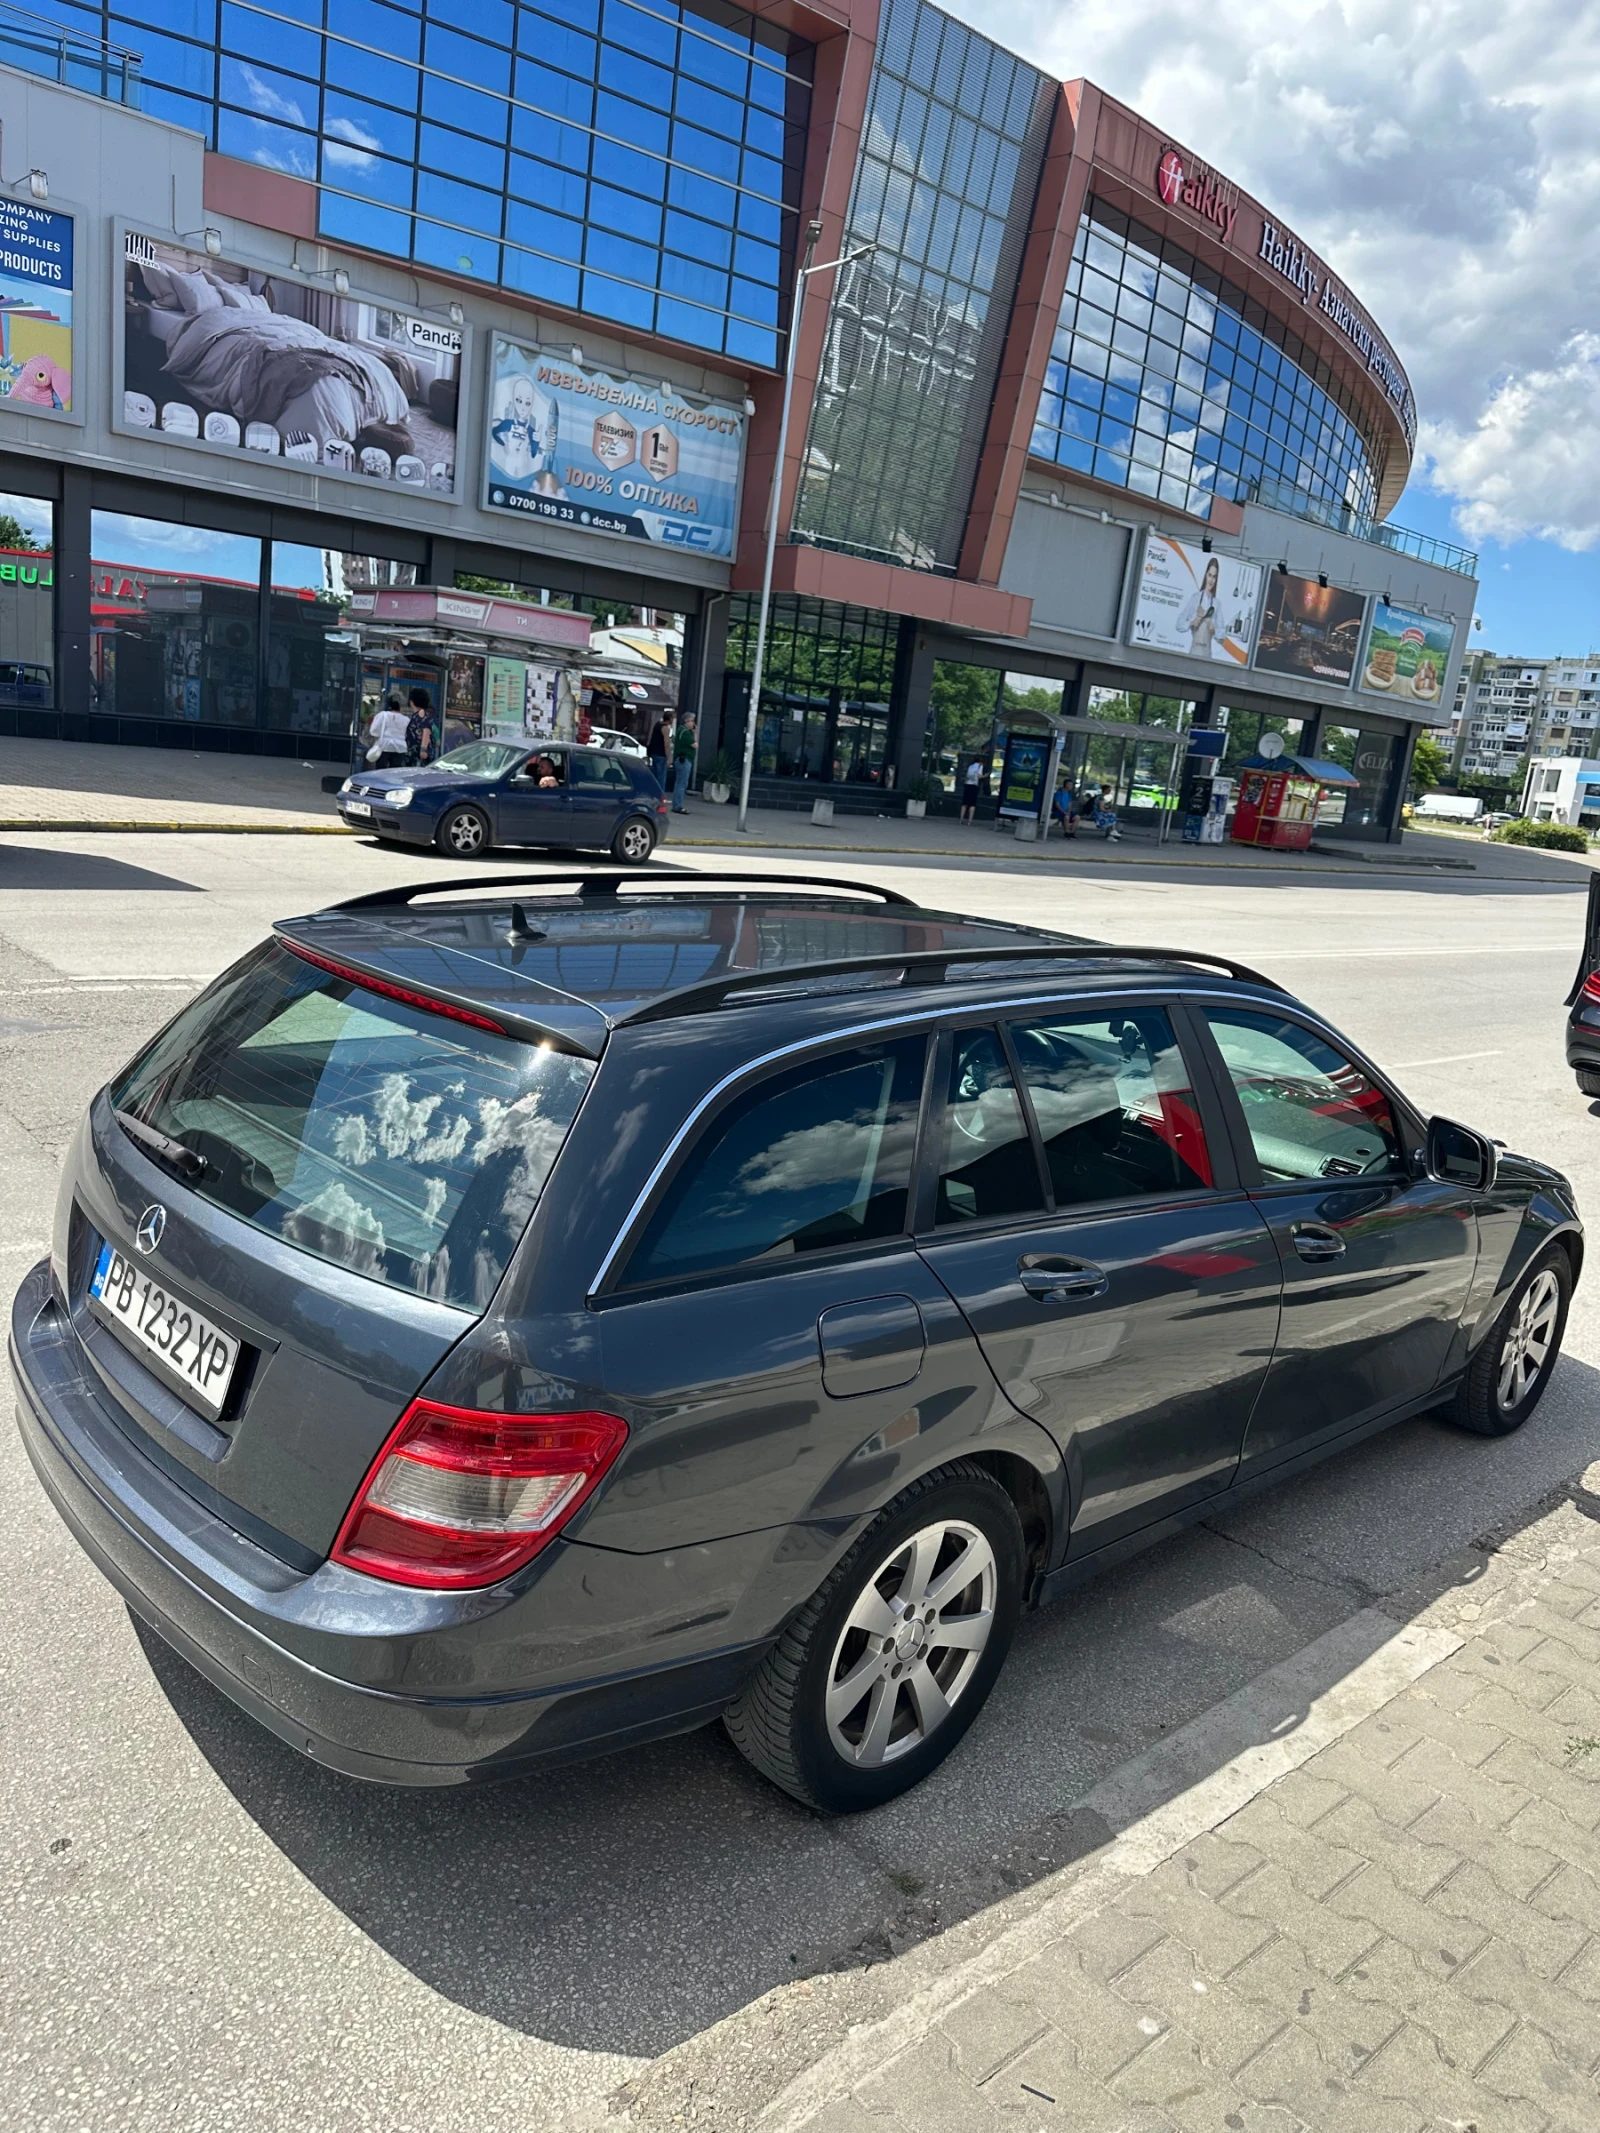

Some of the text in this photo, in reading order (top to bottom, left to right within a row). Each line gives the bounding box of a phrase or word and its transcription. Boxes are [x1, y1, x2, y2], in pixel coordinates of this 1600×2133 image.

[3, 229, 61, 253] SUPPLIES
[1319, 278, 1372, 358] Азиатски
[536, 365, 738, 435] ИЗВЪНЗЕМНА СКОРОСТ
[596, 422, 635, 440] ТЕЛЕВИЗИЯ
[652, 432, 660, 458] 1
[565, 465, 699, 516] 100% ОПТИКА
[509, 495, 627, 534] 0700 199 33 dcc.bg
[446, 603, 472, 615] KING
[94, 1253, 229, 1388] BG PB 1232 XP
